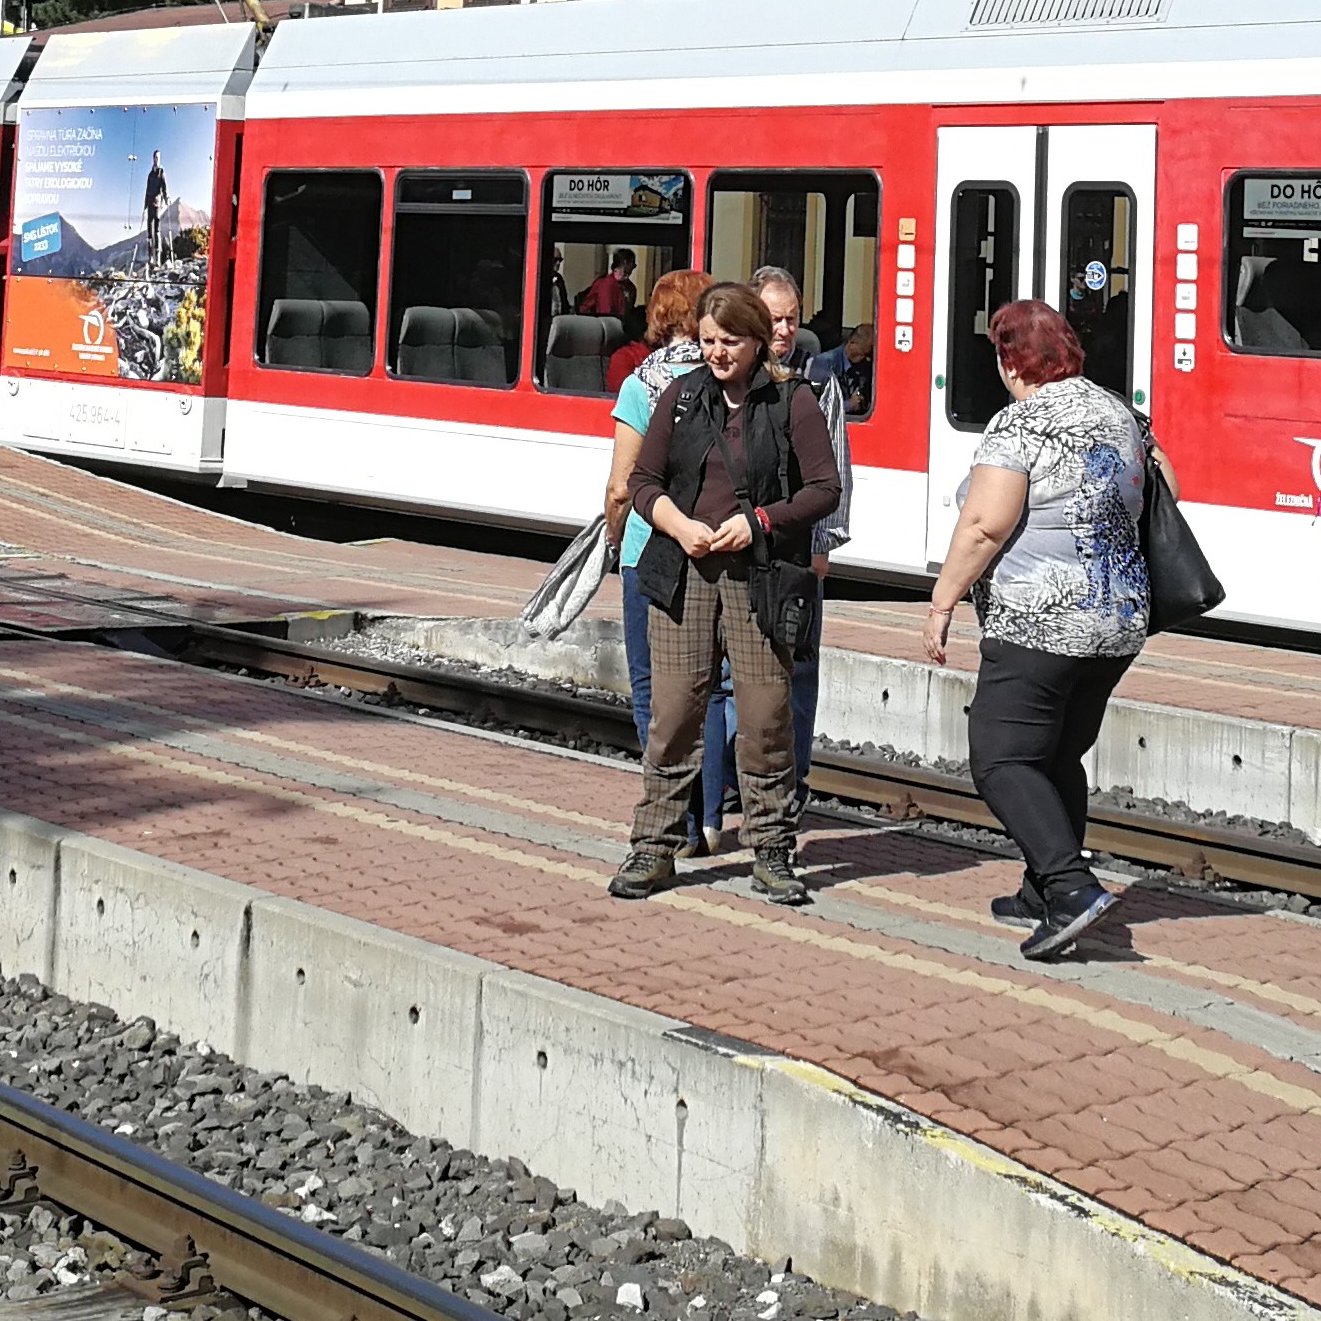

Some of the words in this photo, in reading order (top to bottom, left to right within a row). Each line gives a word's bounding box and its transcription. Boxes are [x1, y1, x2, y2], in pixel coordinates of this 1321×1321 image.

[568, 179, 585, 192] DO
[587, 176, 610, 192] HÔR
[1270, 184, 1295, 200] DO
[69, 403, 121, 424] 425.964-4
